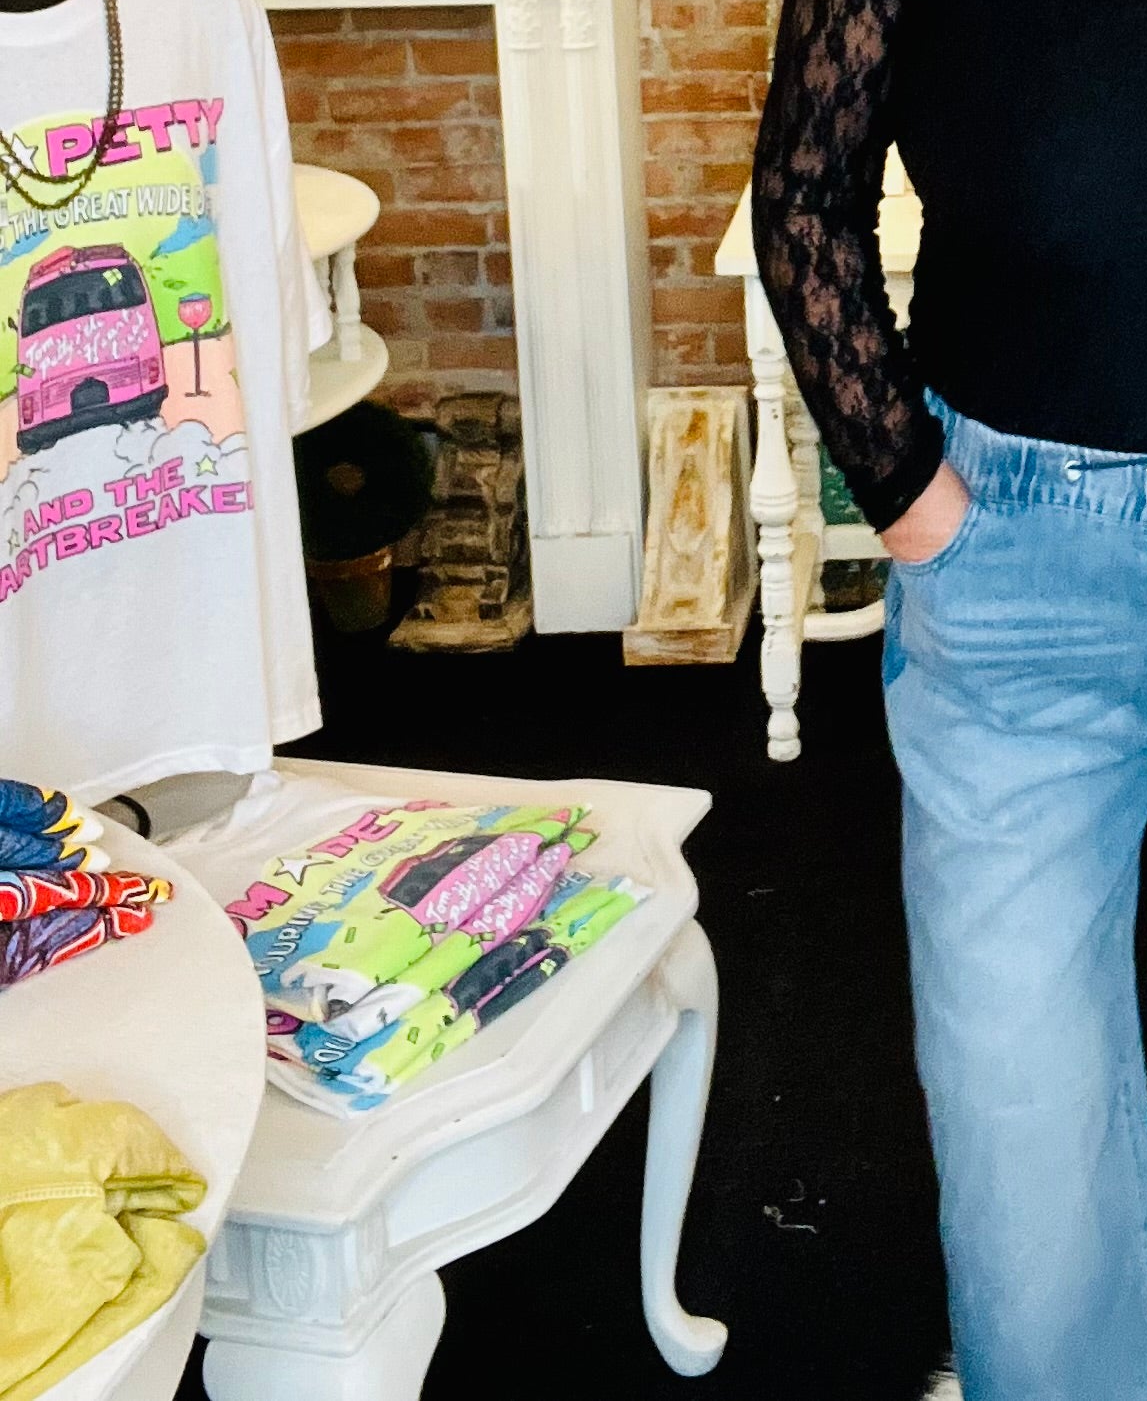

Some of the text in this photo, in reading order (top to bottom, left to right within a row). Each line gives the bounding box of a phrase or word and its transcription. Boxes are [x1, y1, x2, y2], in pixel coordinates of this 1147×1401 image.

[45, 97, 224, 178] PETTY
[8, 209, 49, 244] THE
[53, 188, 131, 230] GREAT
[136, 183, 191, 217] WIDE
[23, 456, 186, 542] AND THE
